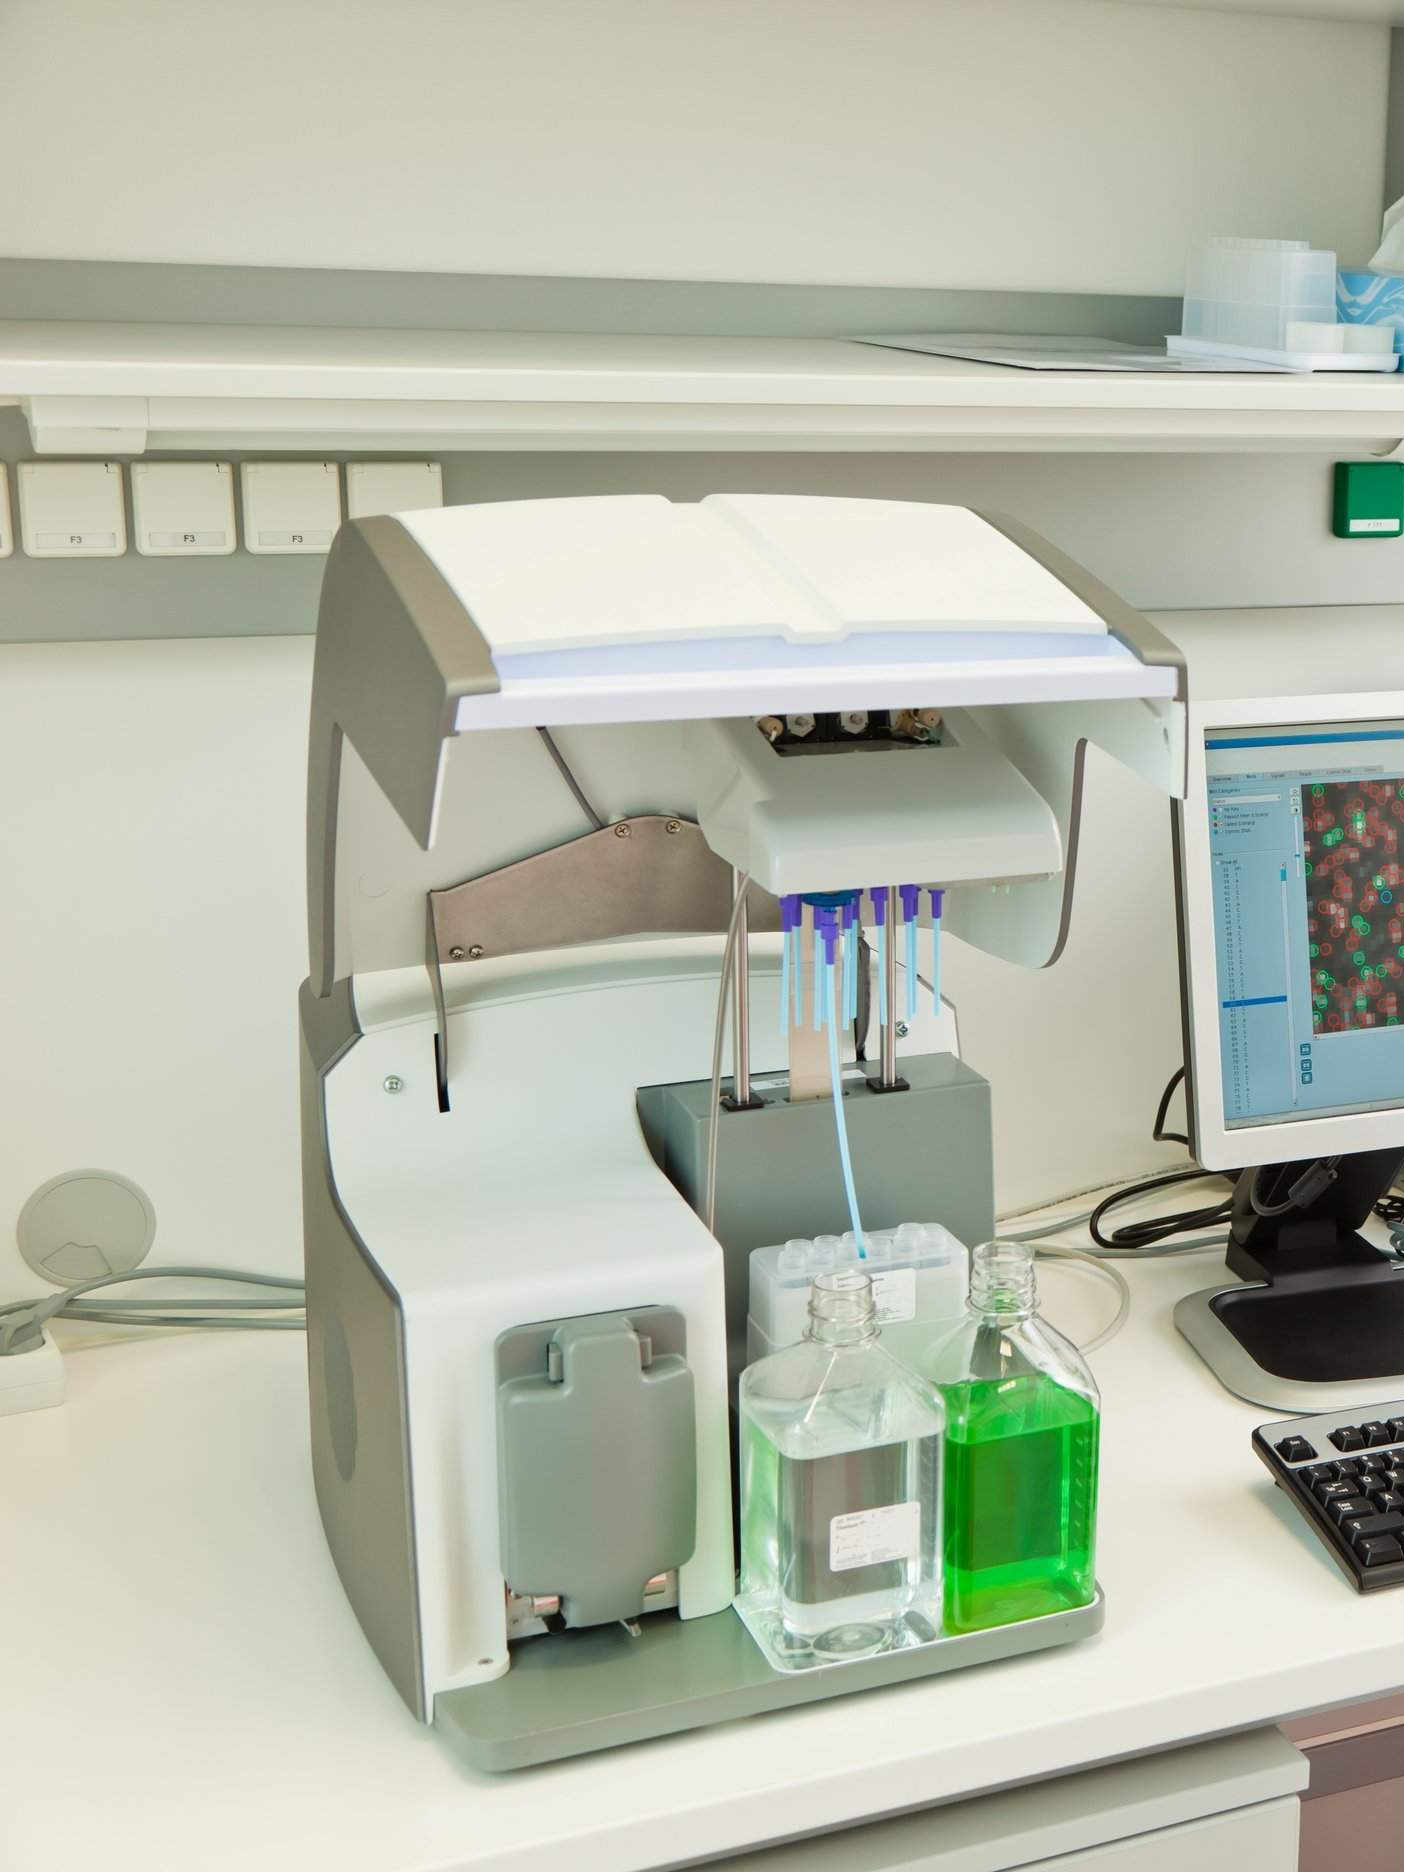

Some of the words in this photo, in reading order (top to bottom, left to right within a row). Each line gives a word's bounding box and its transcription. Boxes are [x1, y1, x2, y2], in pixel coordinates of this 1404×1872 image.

[70, 535, 82, 544] F3
[183, 534, 195, 543] F3
[292, 534, 303, 543] F3
